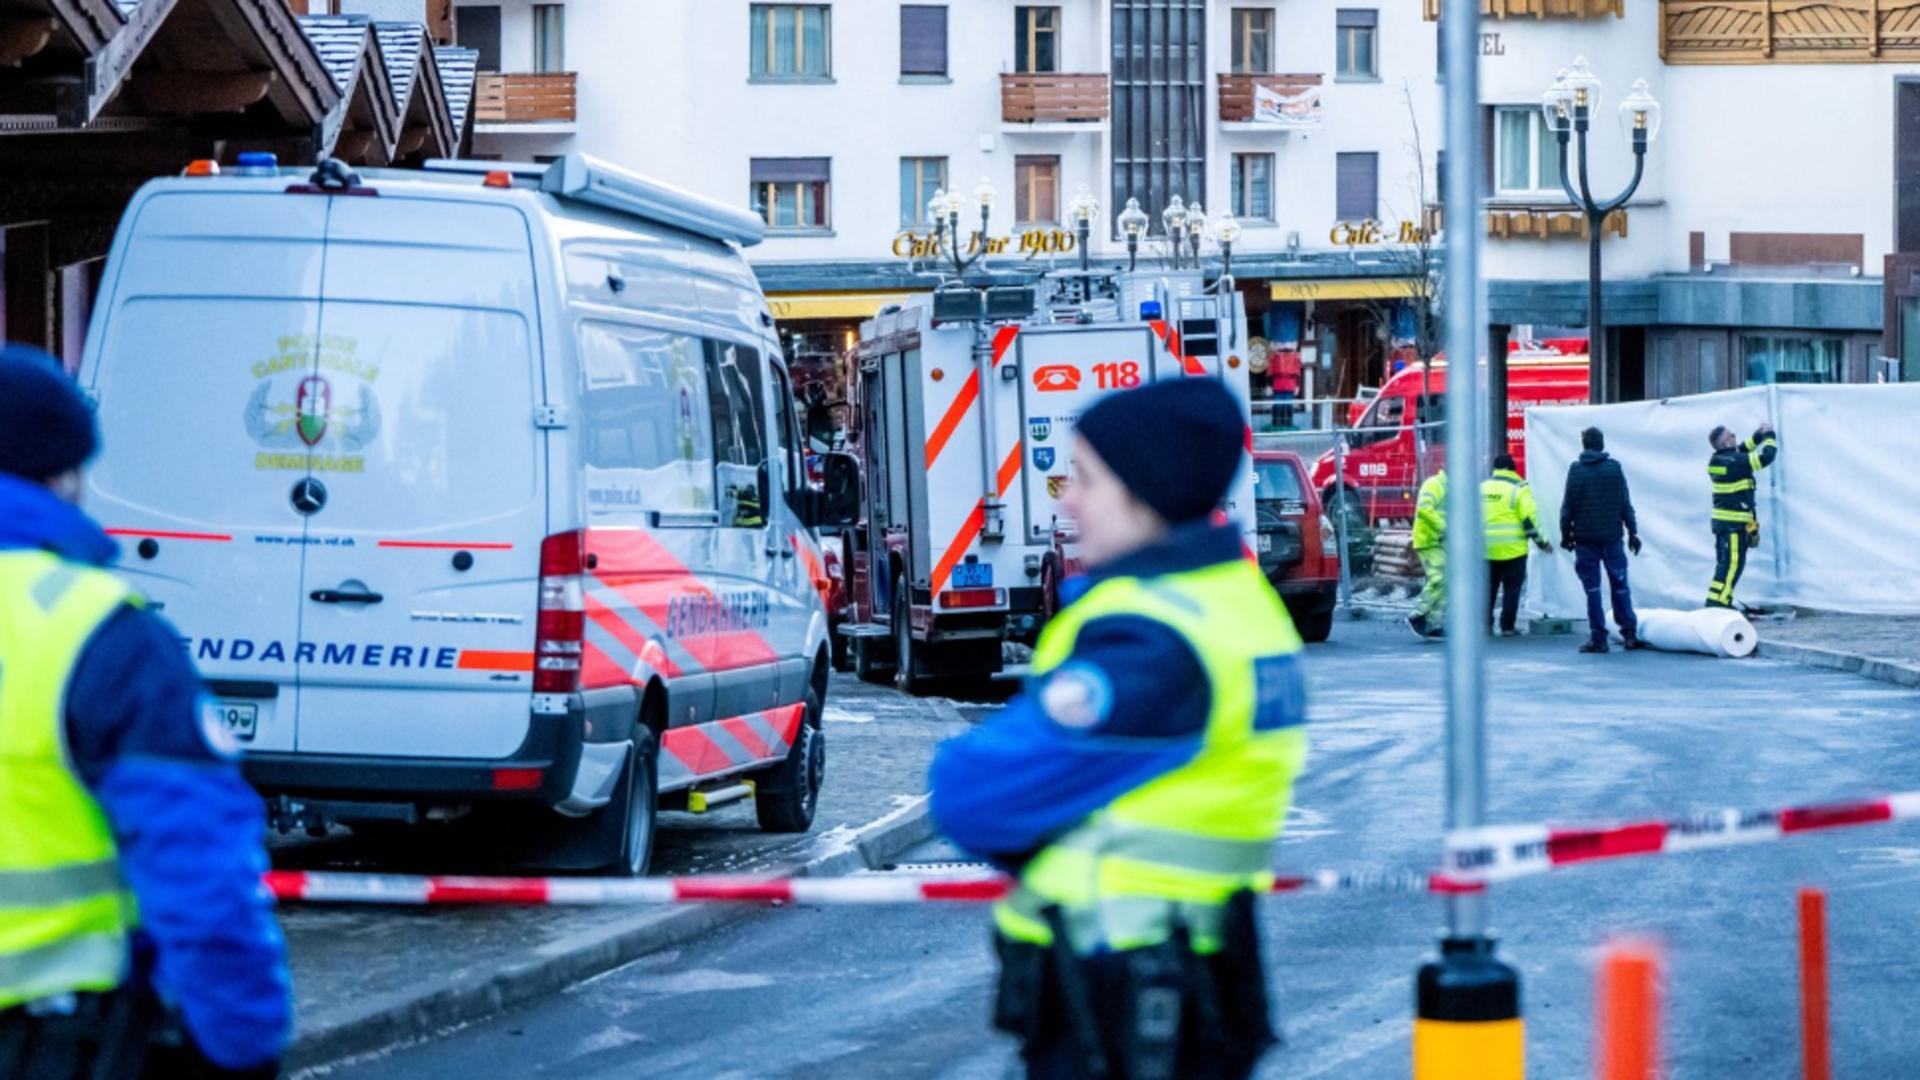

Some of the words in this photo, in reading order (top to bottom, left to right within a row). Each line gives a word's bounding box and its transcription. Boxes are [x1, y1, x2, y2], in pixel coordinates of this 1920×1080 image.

[1018, 229, 1075, 260] 1900
[1091, 361, 1140, 389] 118
[667, 591, 770, 638] GENDARMERIE
[178, 637, 457, 669] NDARMERIE
